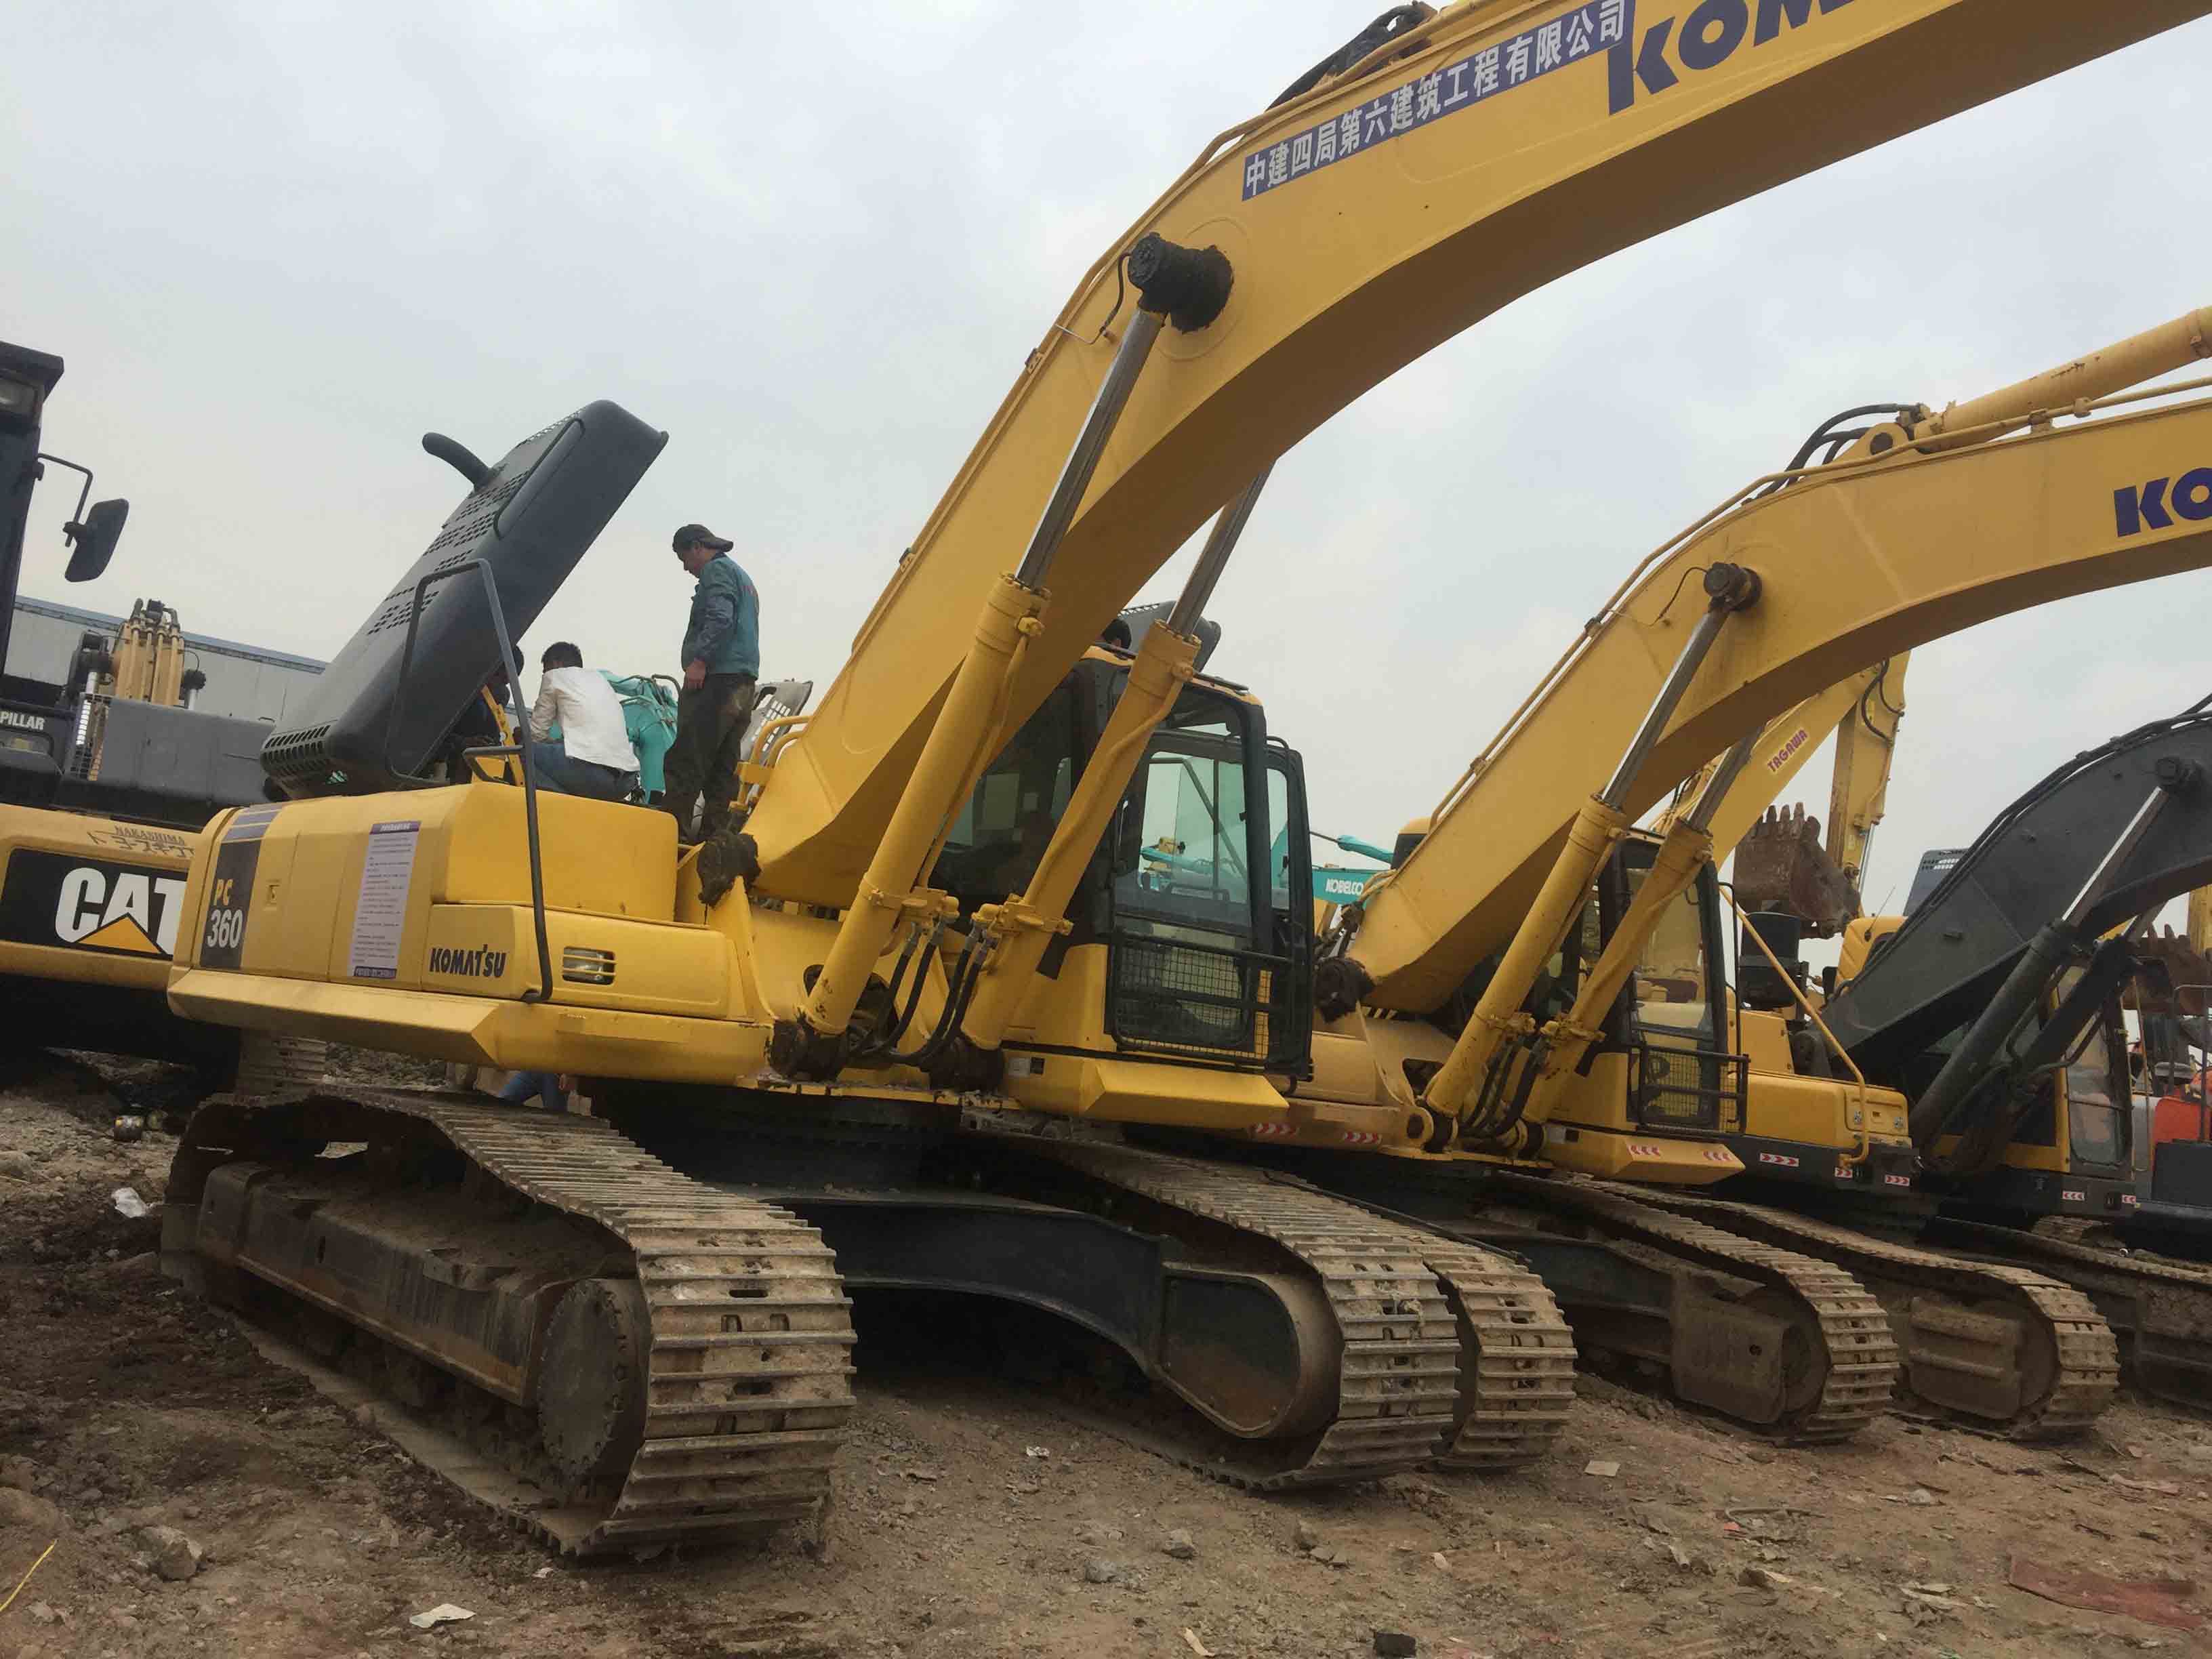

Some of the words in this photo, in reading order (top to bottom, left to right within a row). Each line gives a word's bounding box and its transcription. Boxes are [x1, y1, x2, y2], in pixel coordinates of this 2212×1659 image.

[1246, 0, 1625, 197] 中建四局第六建筑工程有限公司
[2114, 467, 2212, 537] KO
[1767, 729, 1807, 772] TAGAWA
[213, 879, 232, 906] PC
[1326, 878, 1364, 896] KOBELCO
[55, 867, 188, 955] CAT
[207, 909, 243, 948] 360
[429, 944, 507, 977] KOMATSU
